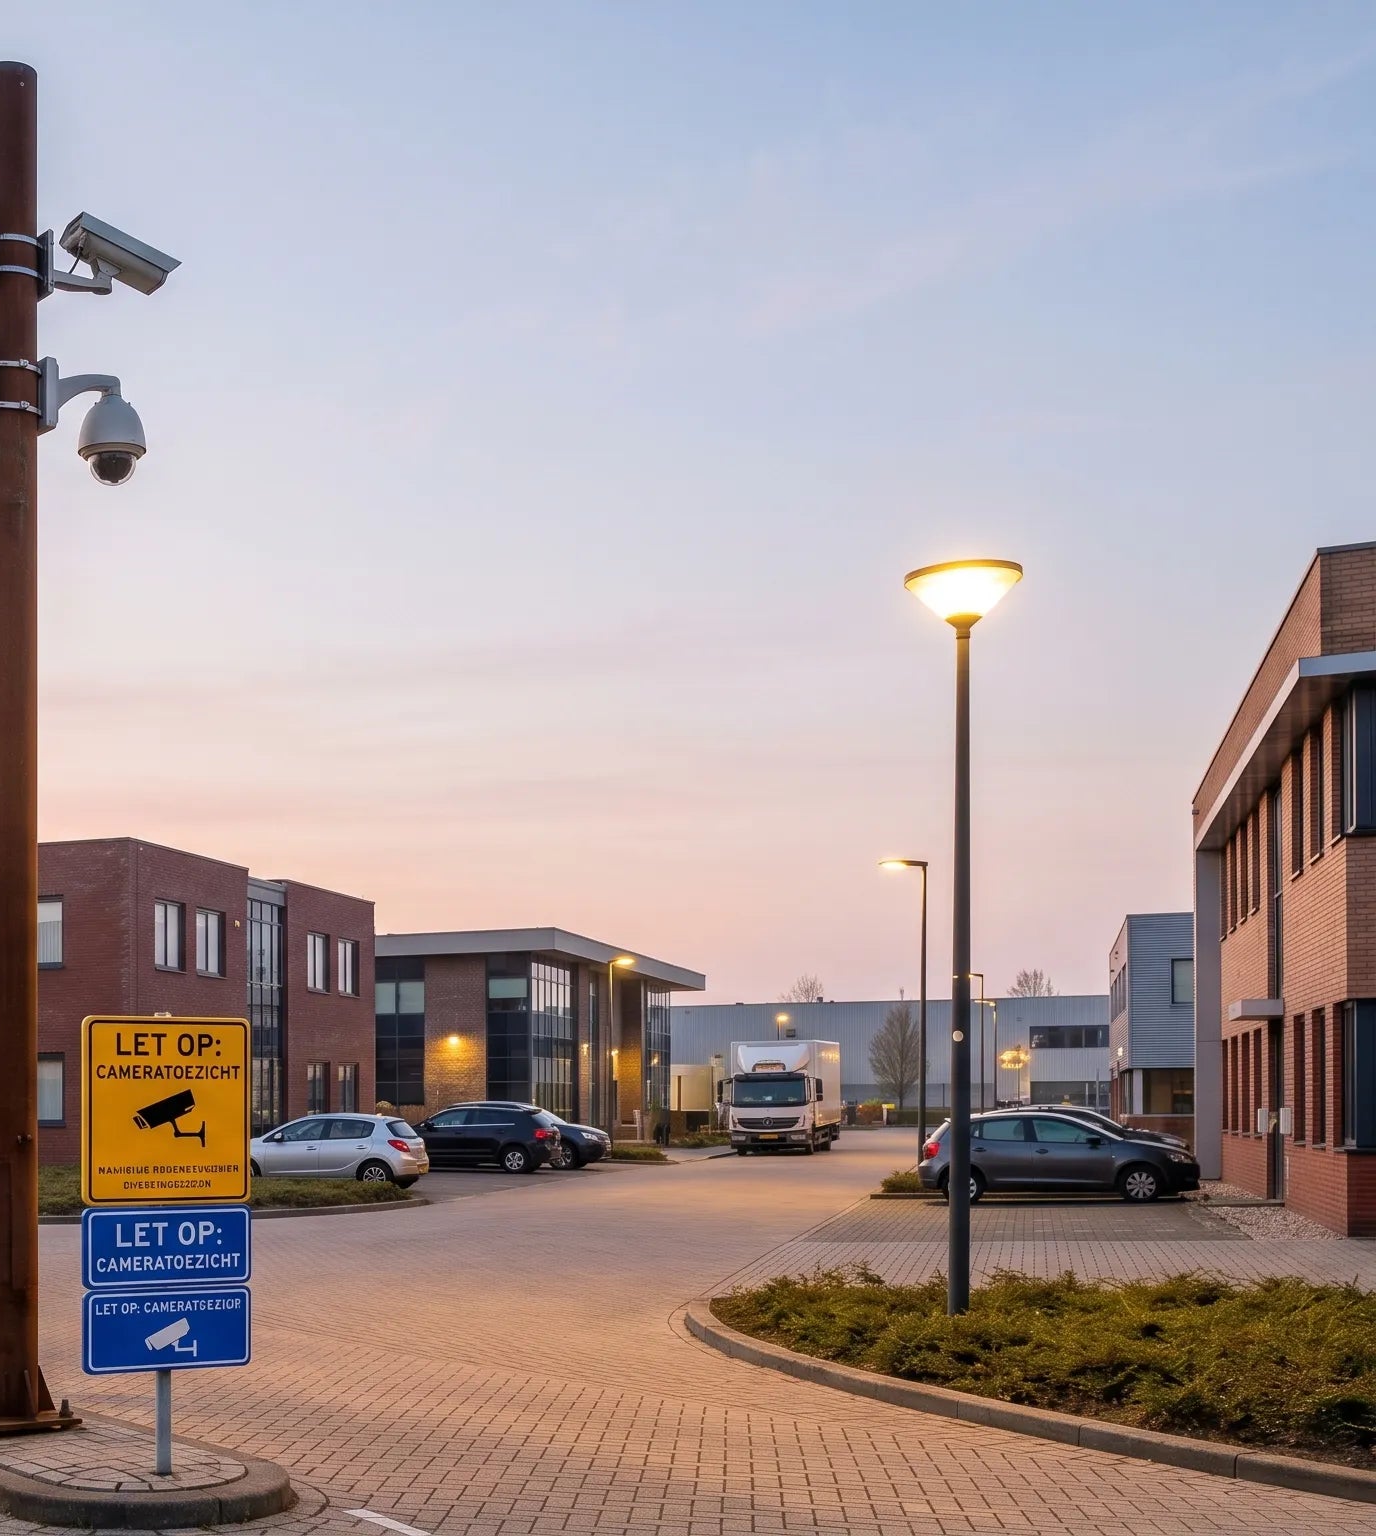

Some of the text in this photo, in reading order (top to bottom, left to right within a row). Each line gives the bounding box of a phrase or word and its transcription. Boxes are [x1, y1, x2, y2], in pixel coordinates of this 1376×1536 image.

[116, 1032, 222, 1057] LET OP:
[96, 1064, 241, 1080] CAMERATOEZICHT
[116, 1220, 222, 1248] LET OP:
[96, 1252, 241, 1273] CAMERATOEZICHT
[95, 1303, 118, 1316] LET
[121, 1302, 140, 1315] OP:
